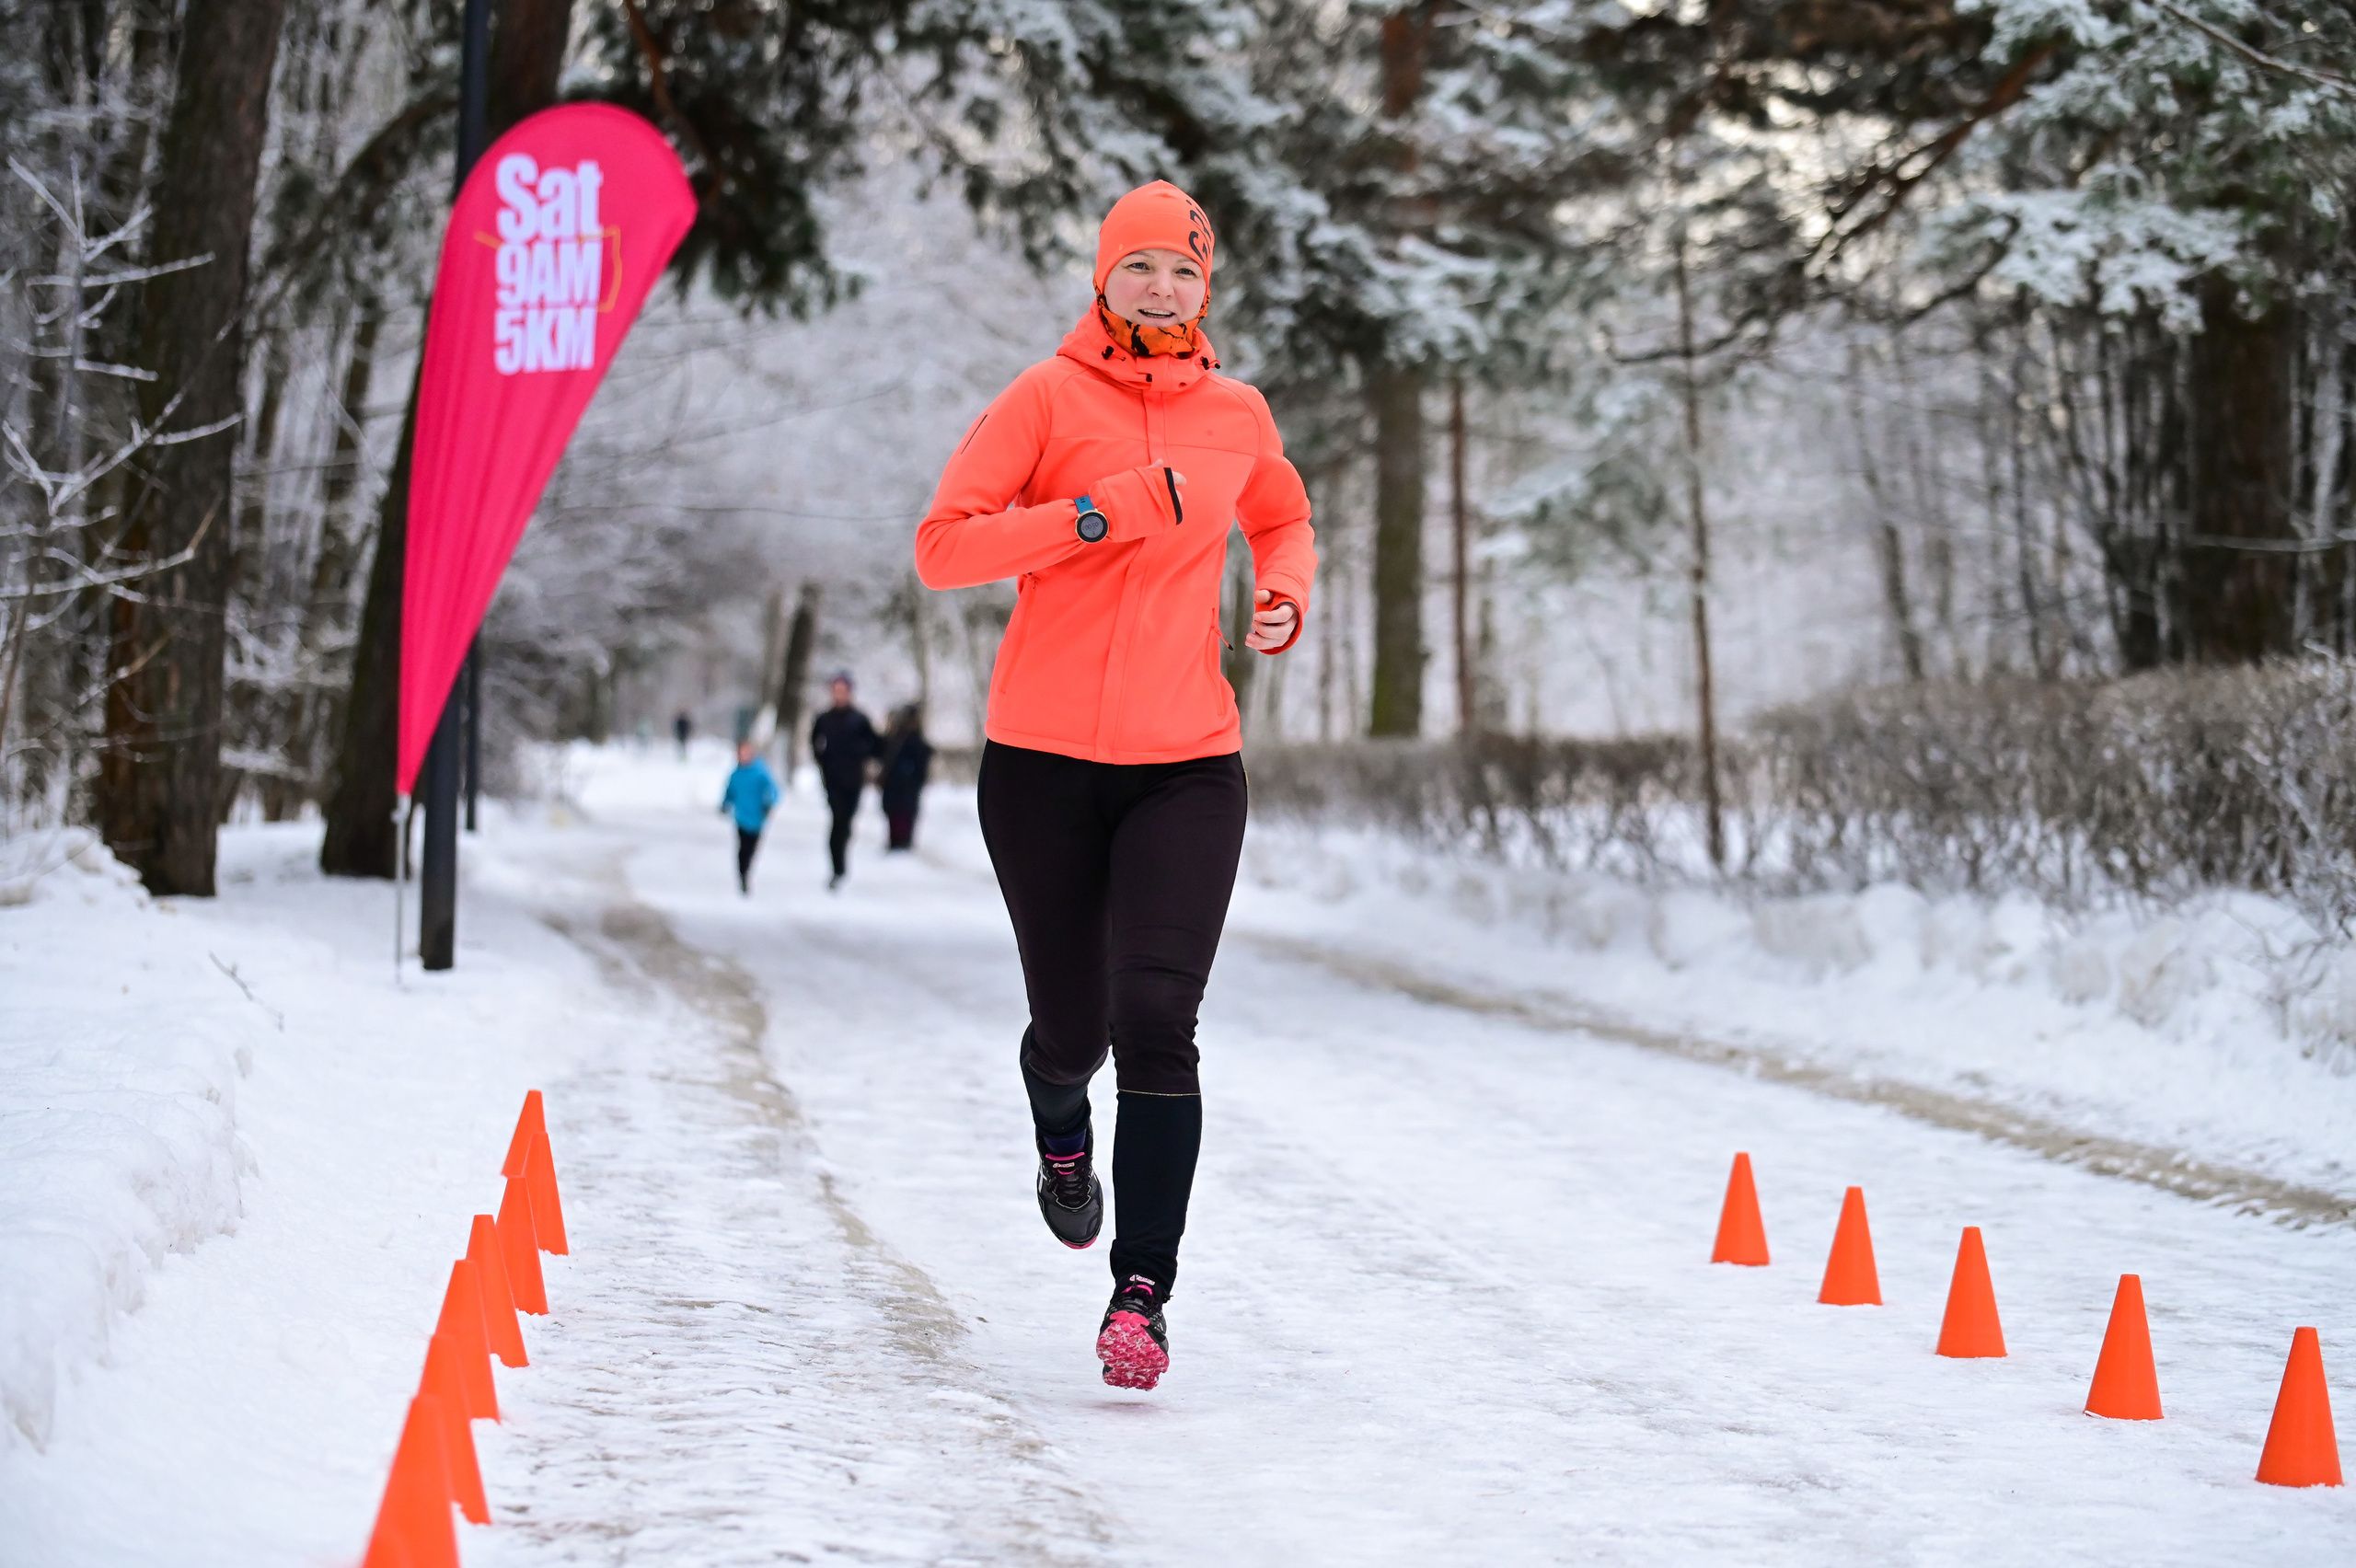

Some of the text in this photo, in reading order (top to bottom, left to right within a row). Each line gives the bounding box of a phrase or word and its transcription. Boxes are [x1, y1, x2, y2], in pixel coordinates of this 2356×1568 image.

[496, 153, 604, 242] Sat
[496, 242, 603, 306] 9AM
[495, 307, 597, 375] 5KM
